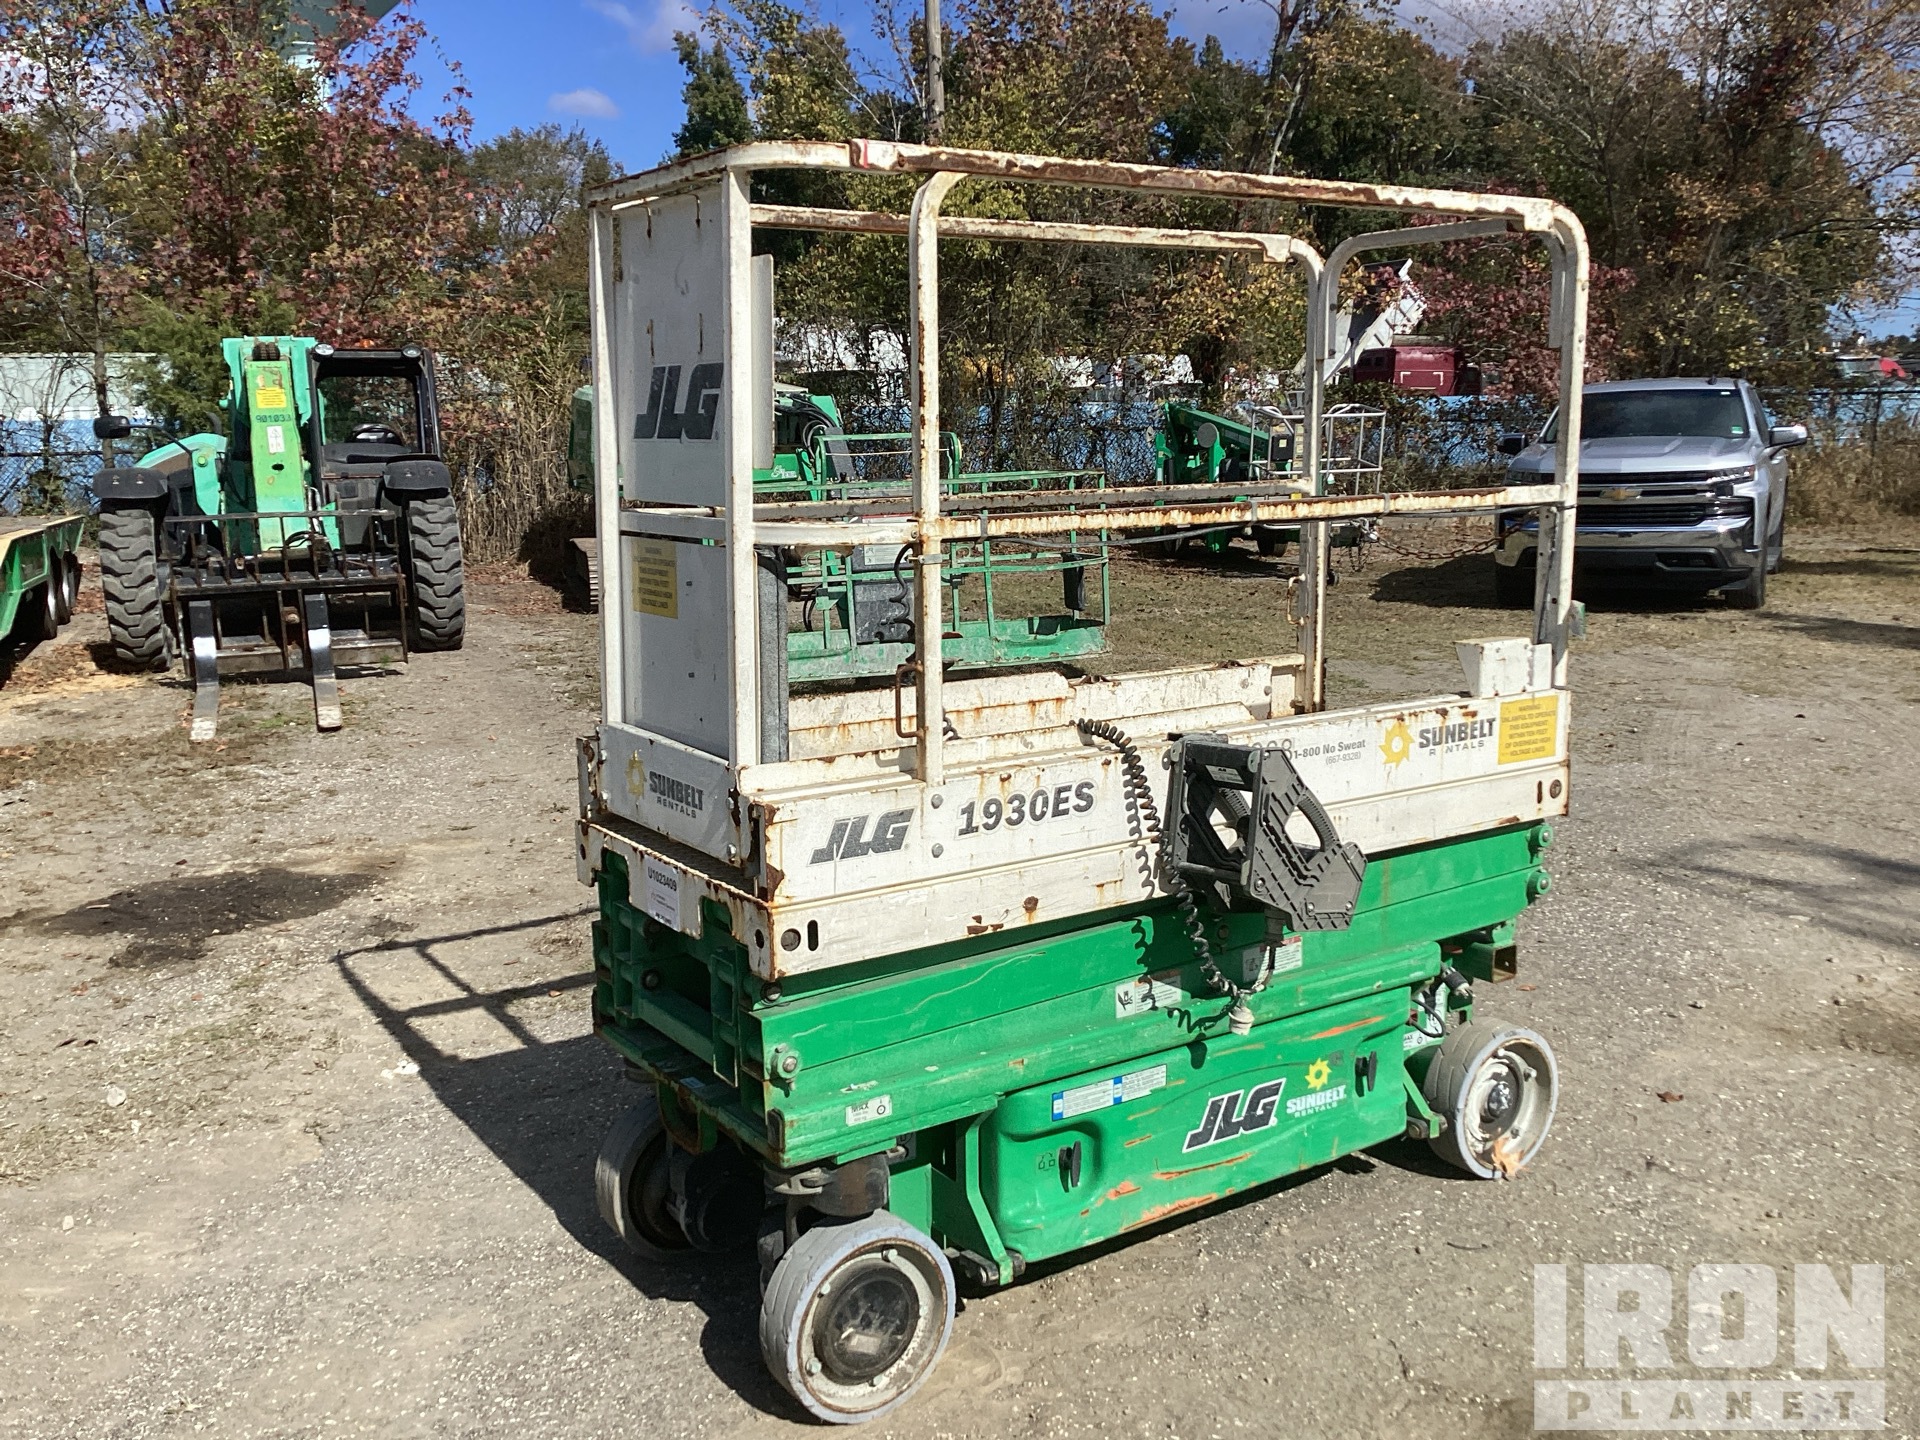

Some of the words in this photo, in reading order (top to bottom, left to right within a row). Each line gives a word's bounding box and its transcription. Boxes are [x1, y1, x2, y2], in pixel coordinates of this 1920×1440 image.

[634, 363, 724, 439] JLG
[1419, 718, 1496, 748] SUNBELT
[1429, 740, 1485, 756] RNTALS
[1293, 746, 1320, 759] 1-800
[1322, 743, 1336, 754] No
[1337, 739, 1366, 752] Sweat
[649, 770, 704, 810] SUNBELT
[656, 796, 697, 818] RENTALS
[957, 781, 1095, 836] 1930ES
[808, 808, 916, 864] JLG
[1286, 1084, 1347, 1114] SUNBELT
[1294, 1101, 1338, 1118] RENTALS
[1183, 1079, 1285, 1152] JLG
